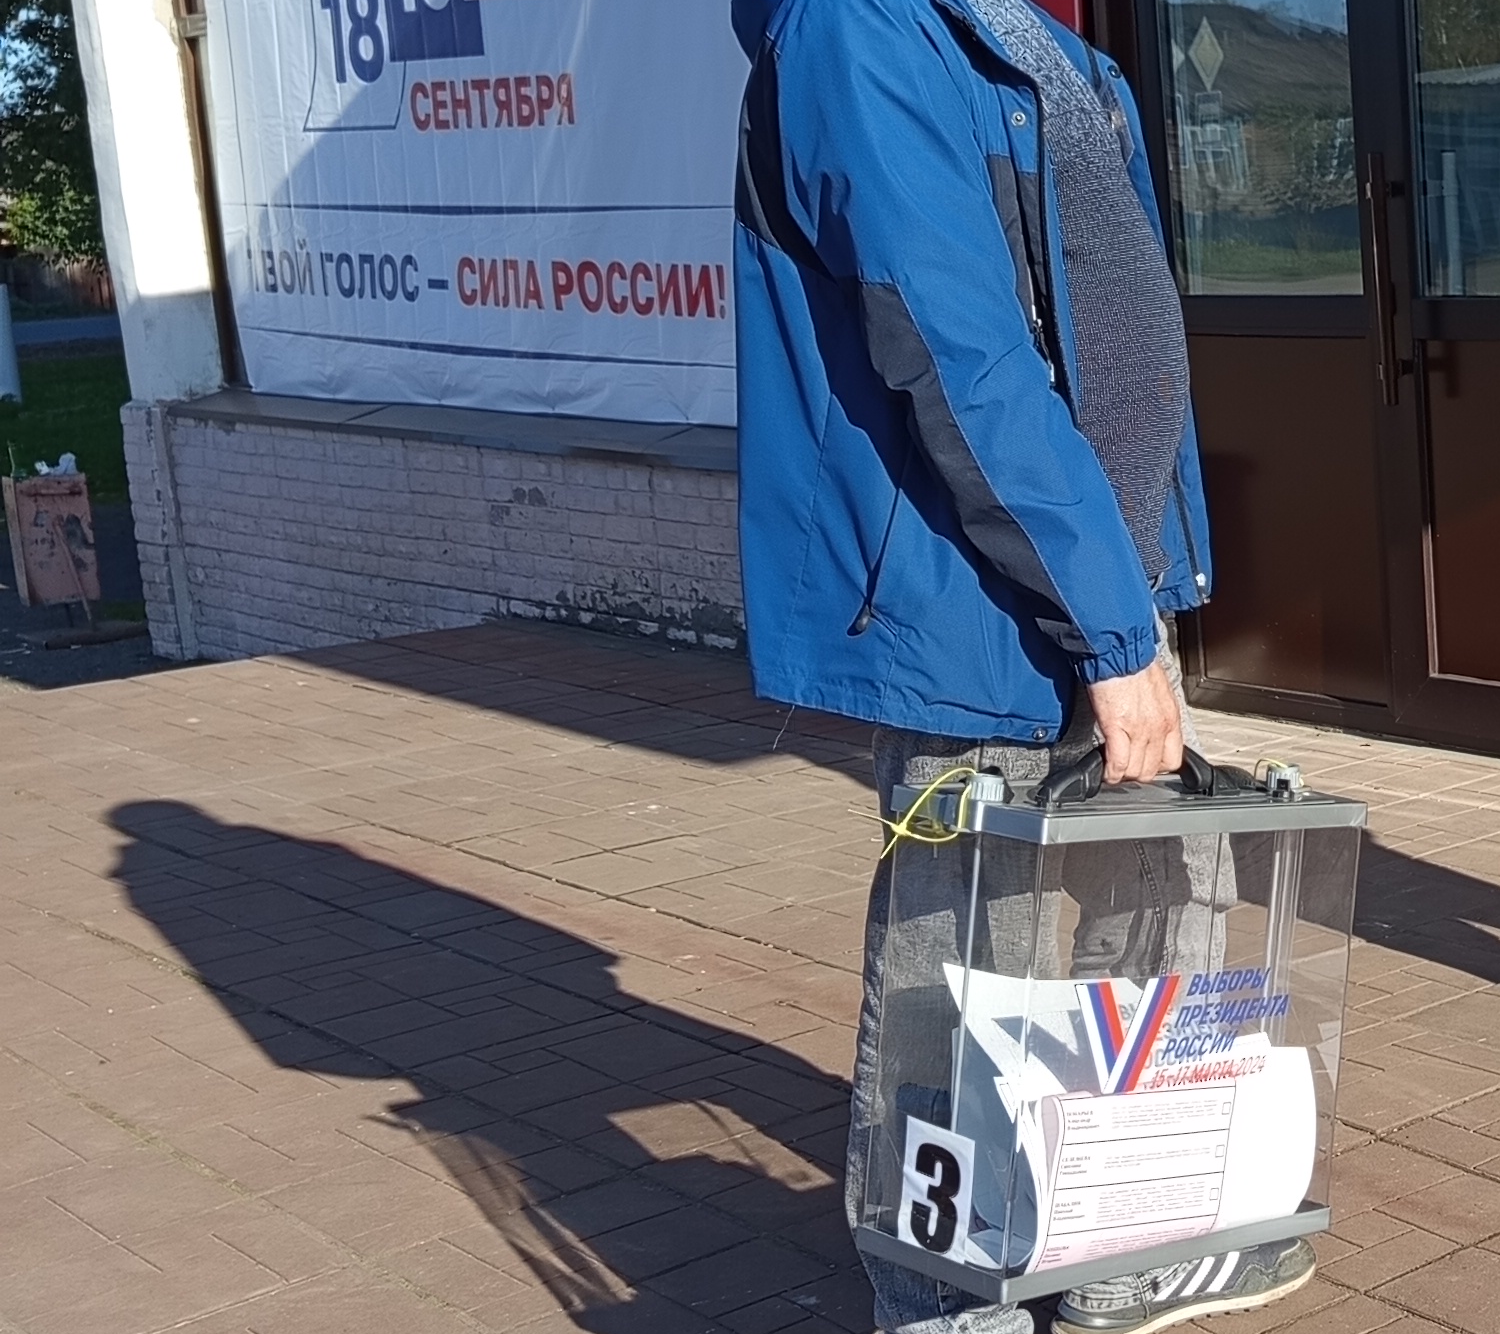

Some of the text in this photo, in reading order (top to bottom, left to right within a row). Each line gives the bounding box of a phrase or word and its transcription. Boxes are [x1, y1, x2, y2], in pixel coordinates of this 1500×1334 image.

[410, 73, 575, 131] СЕНТЯБРЯ
[320, 252, 420, 303] ГОЛОС
[456, 256, 545, 310] СИЛА
[552, 259, 727, 320] РОССИИ!
[1186, 968, 1271, 997] ВЫБОРЫ
[1173, 994, 1290, 1029] ПРЕЗИДЕНТА
[1160, 1030, 1238, 1061] РОССИИ
[1234, 1055, 1266, 1078] 2024
[908, 1142, 962, 1255] 3
